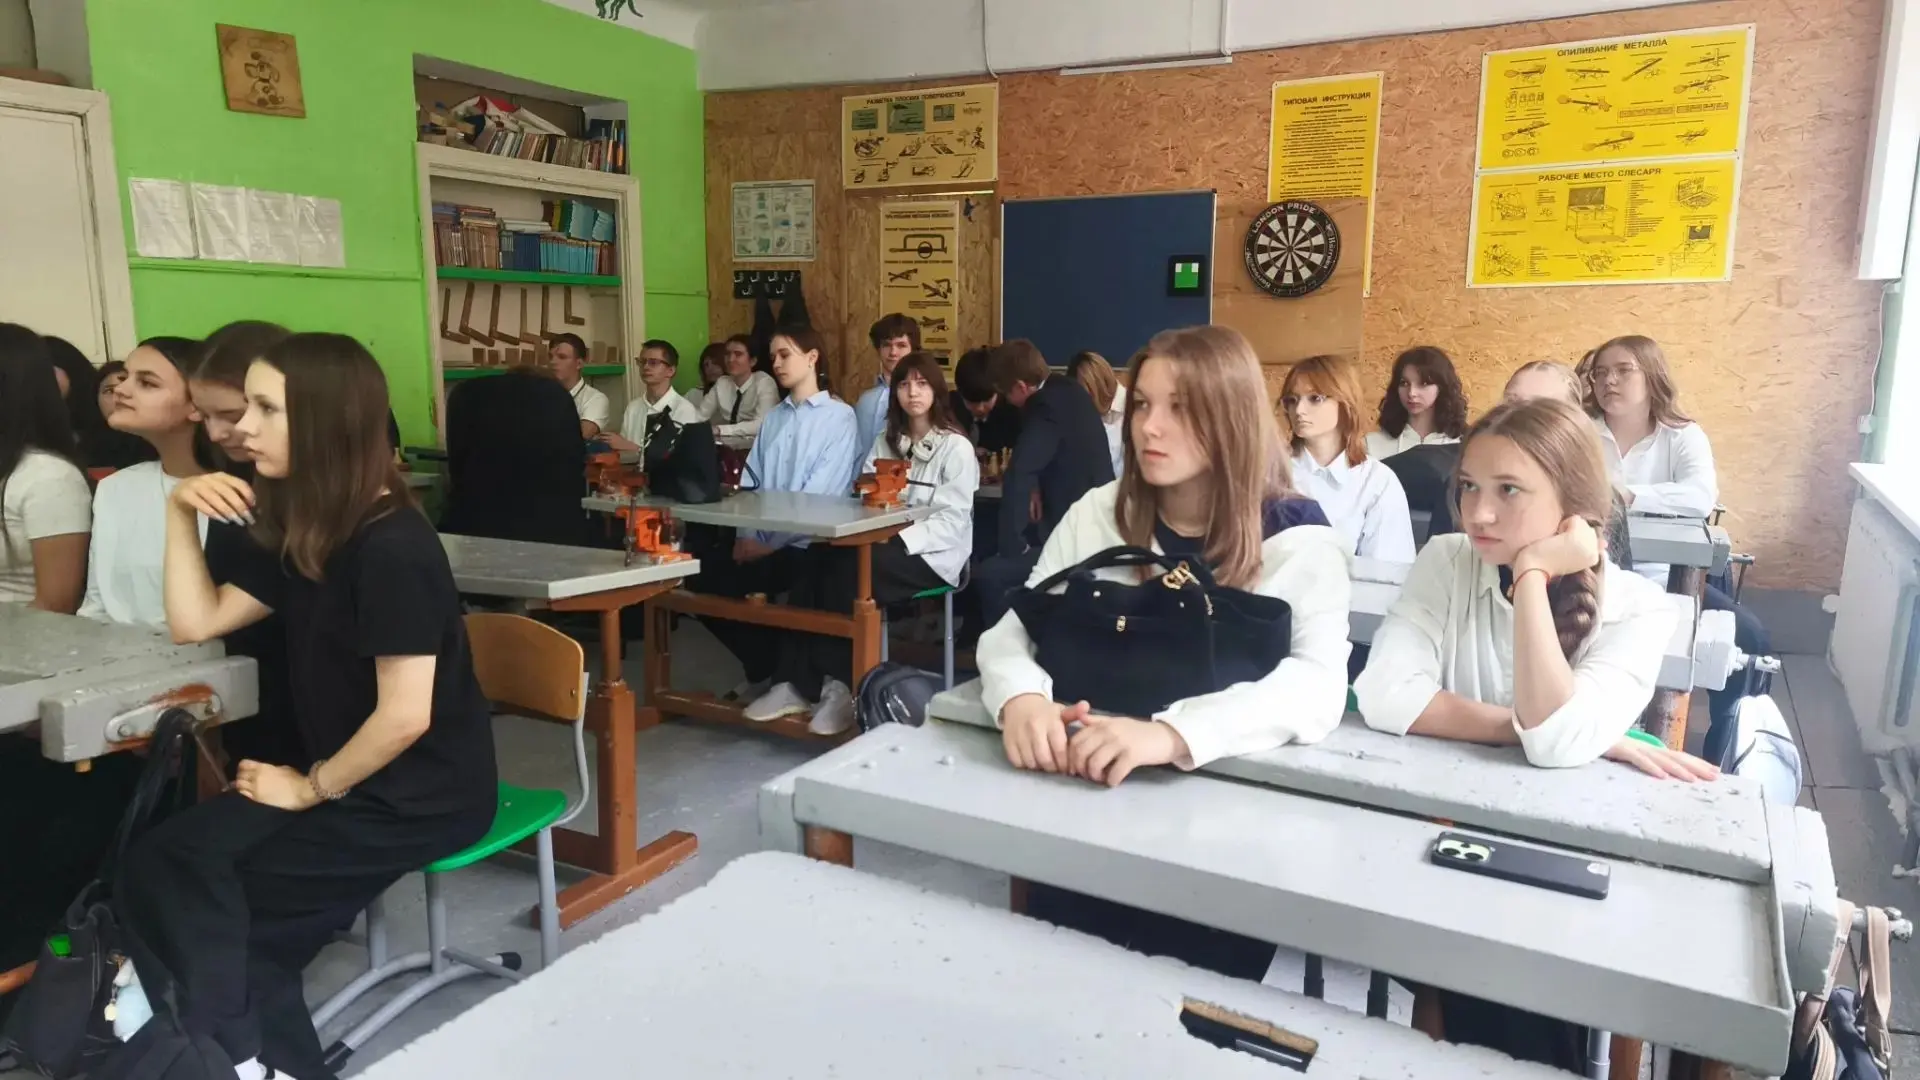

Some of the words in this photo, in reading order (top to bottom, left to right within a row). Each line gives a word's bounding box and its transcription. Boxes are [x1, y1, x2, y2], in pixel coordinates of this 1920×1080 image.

[1557, 44, 1618, 57] ОПИЛИВАНИЕ
[1624, 39, 1668, 50] МЕТАЛЛА
[1283, 97, 1318, 106] ТИПОВАЯ
[1322, 92, 1371, 103] ИНСТРУКЦИЯ
[1538, 172, 1580, 182] РАБОЧЕЕ
[1583, 170, 1614, 179] МЕСТО
[1618, 168, 1662, 177] СЛЕСАРЯ
[1252, 205, 1285, 234] LONDON
[1287, 202, 1317, 214] PRIDE
